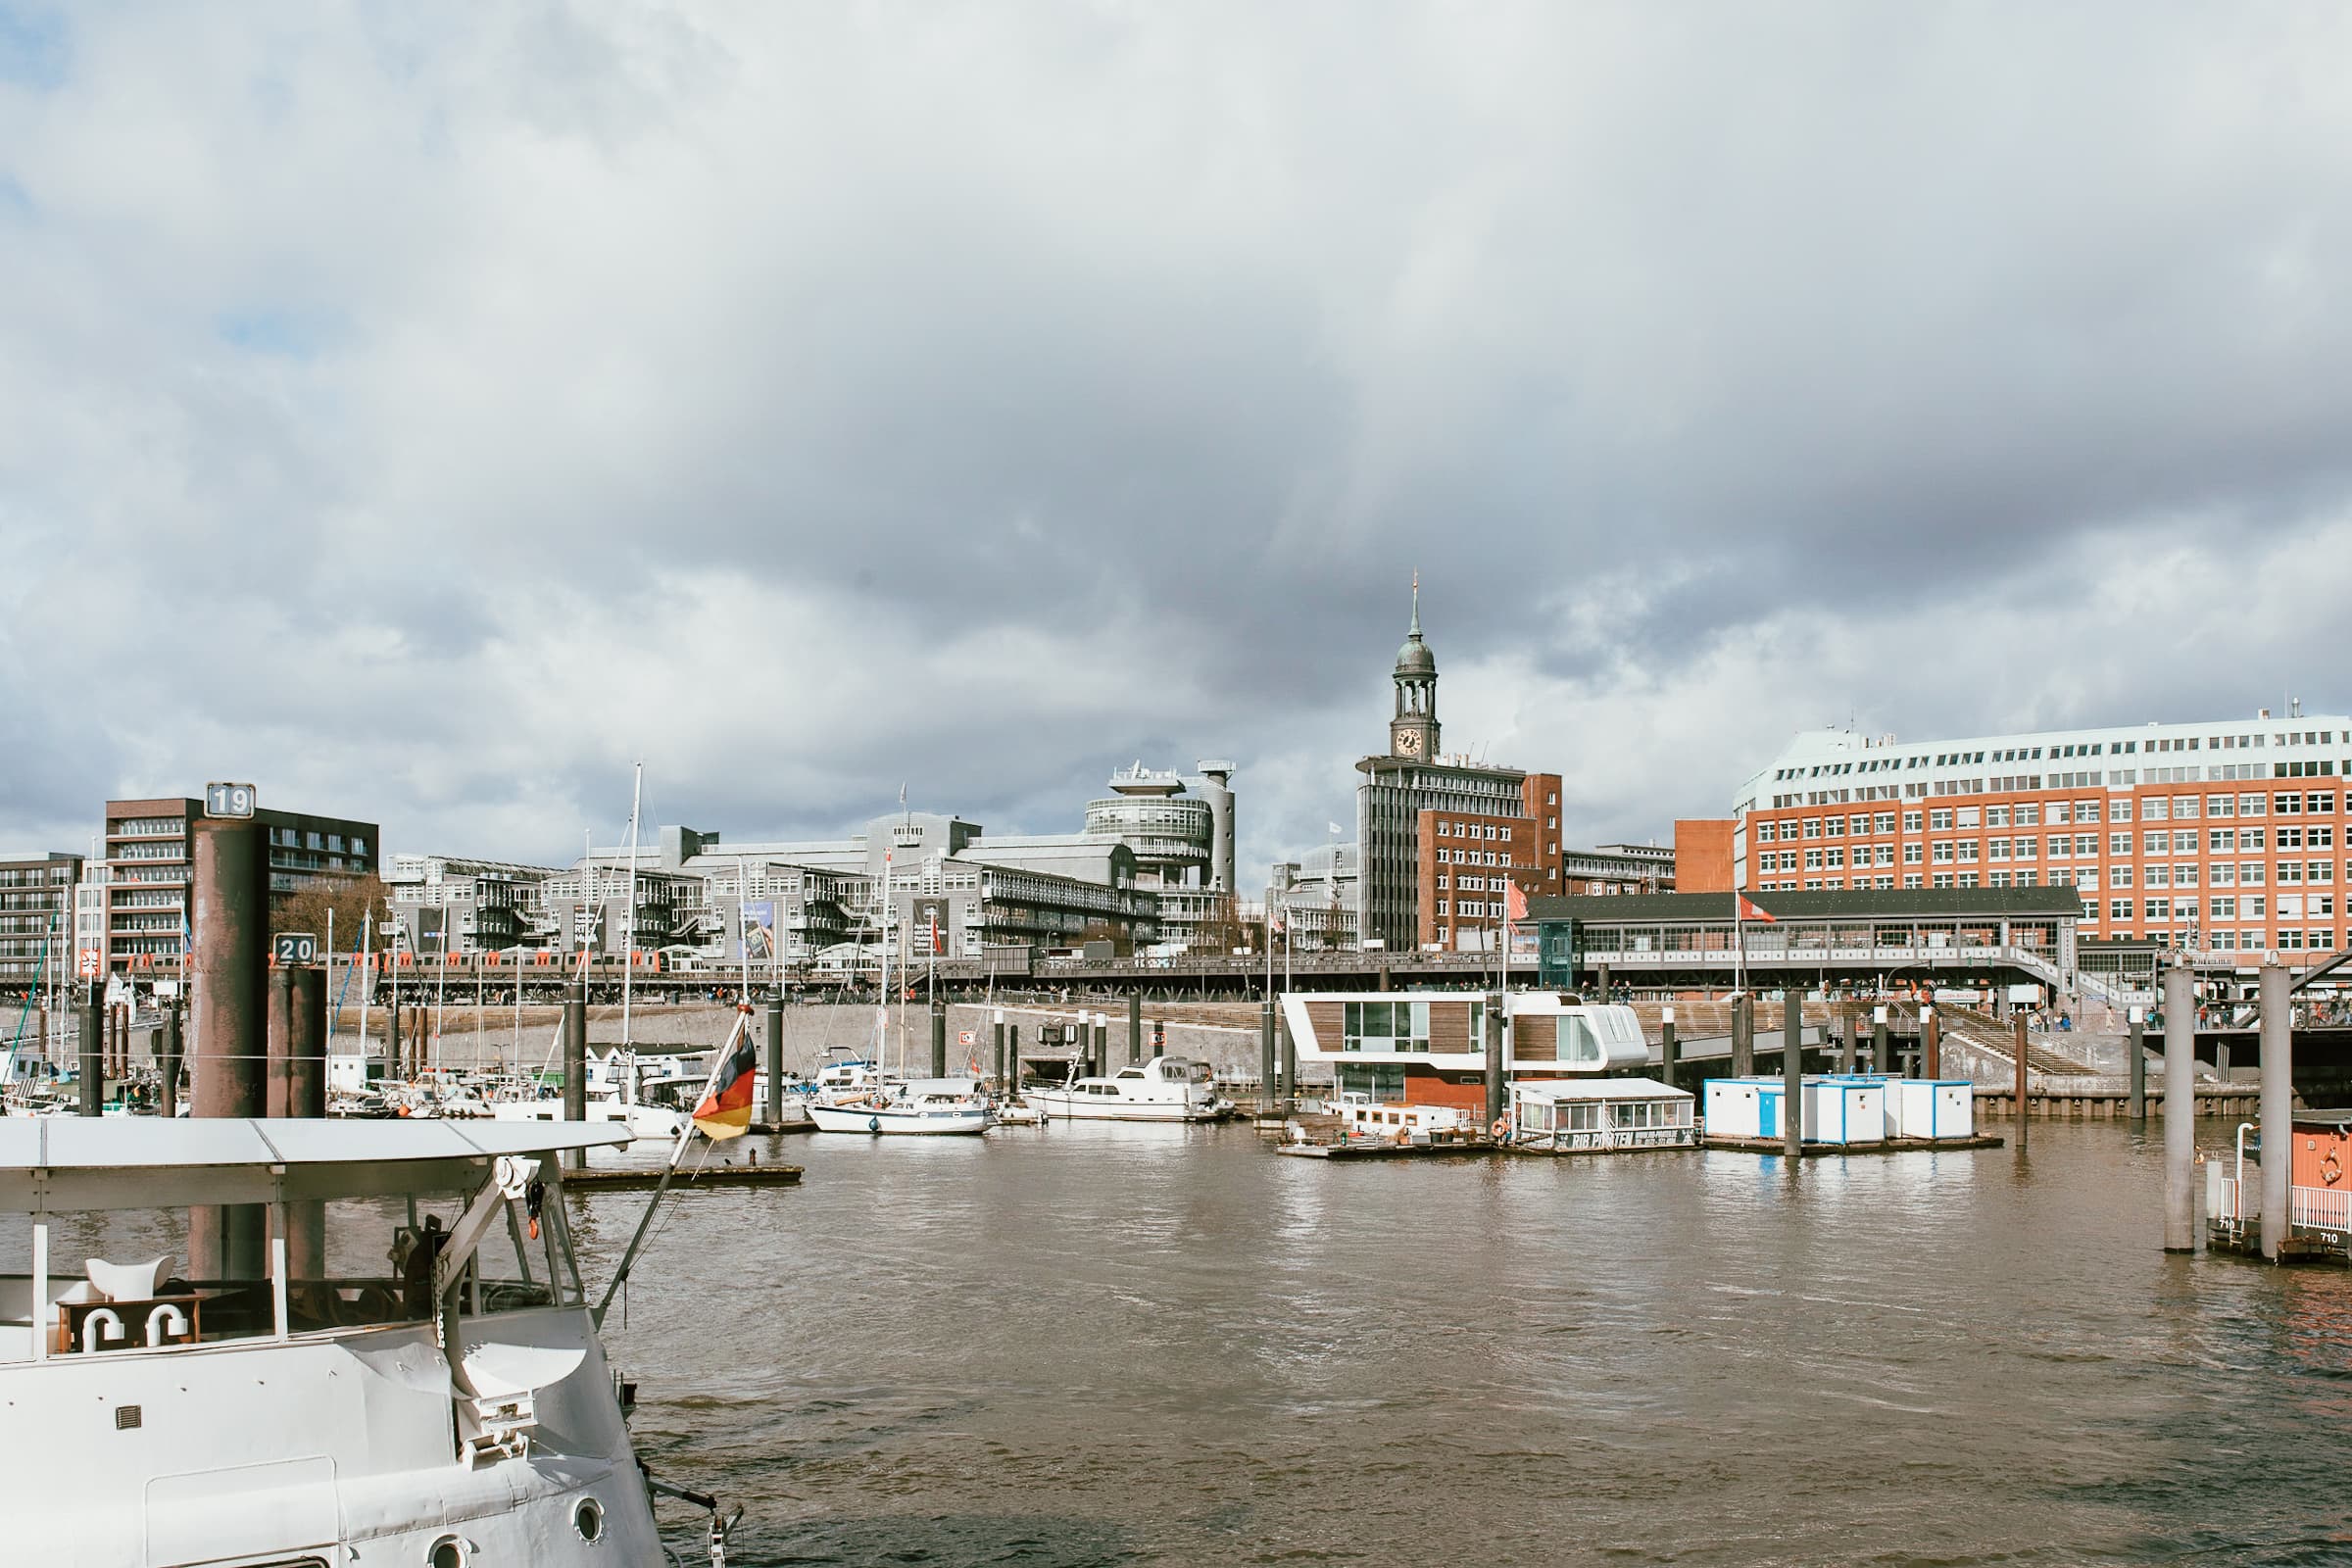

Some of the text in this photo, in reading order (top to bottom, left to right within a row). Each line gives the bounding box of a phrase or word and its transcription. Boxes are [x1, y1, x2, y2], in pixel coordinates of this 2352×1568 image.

[215, 789, 247, 811] 19
[280, 940, 312, 959] 20
[1572, 1133, 1590, 1150] RIB
[1592, 1131, 1634, 1149] PITEN
[2219, 1219, 2235, 1229] 710
[2320, 1232, 2338, 1244] 710
